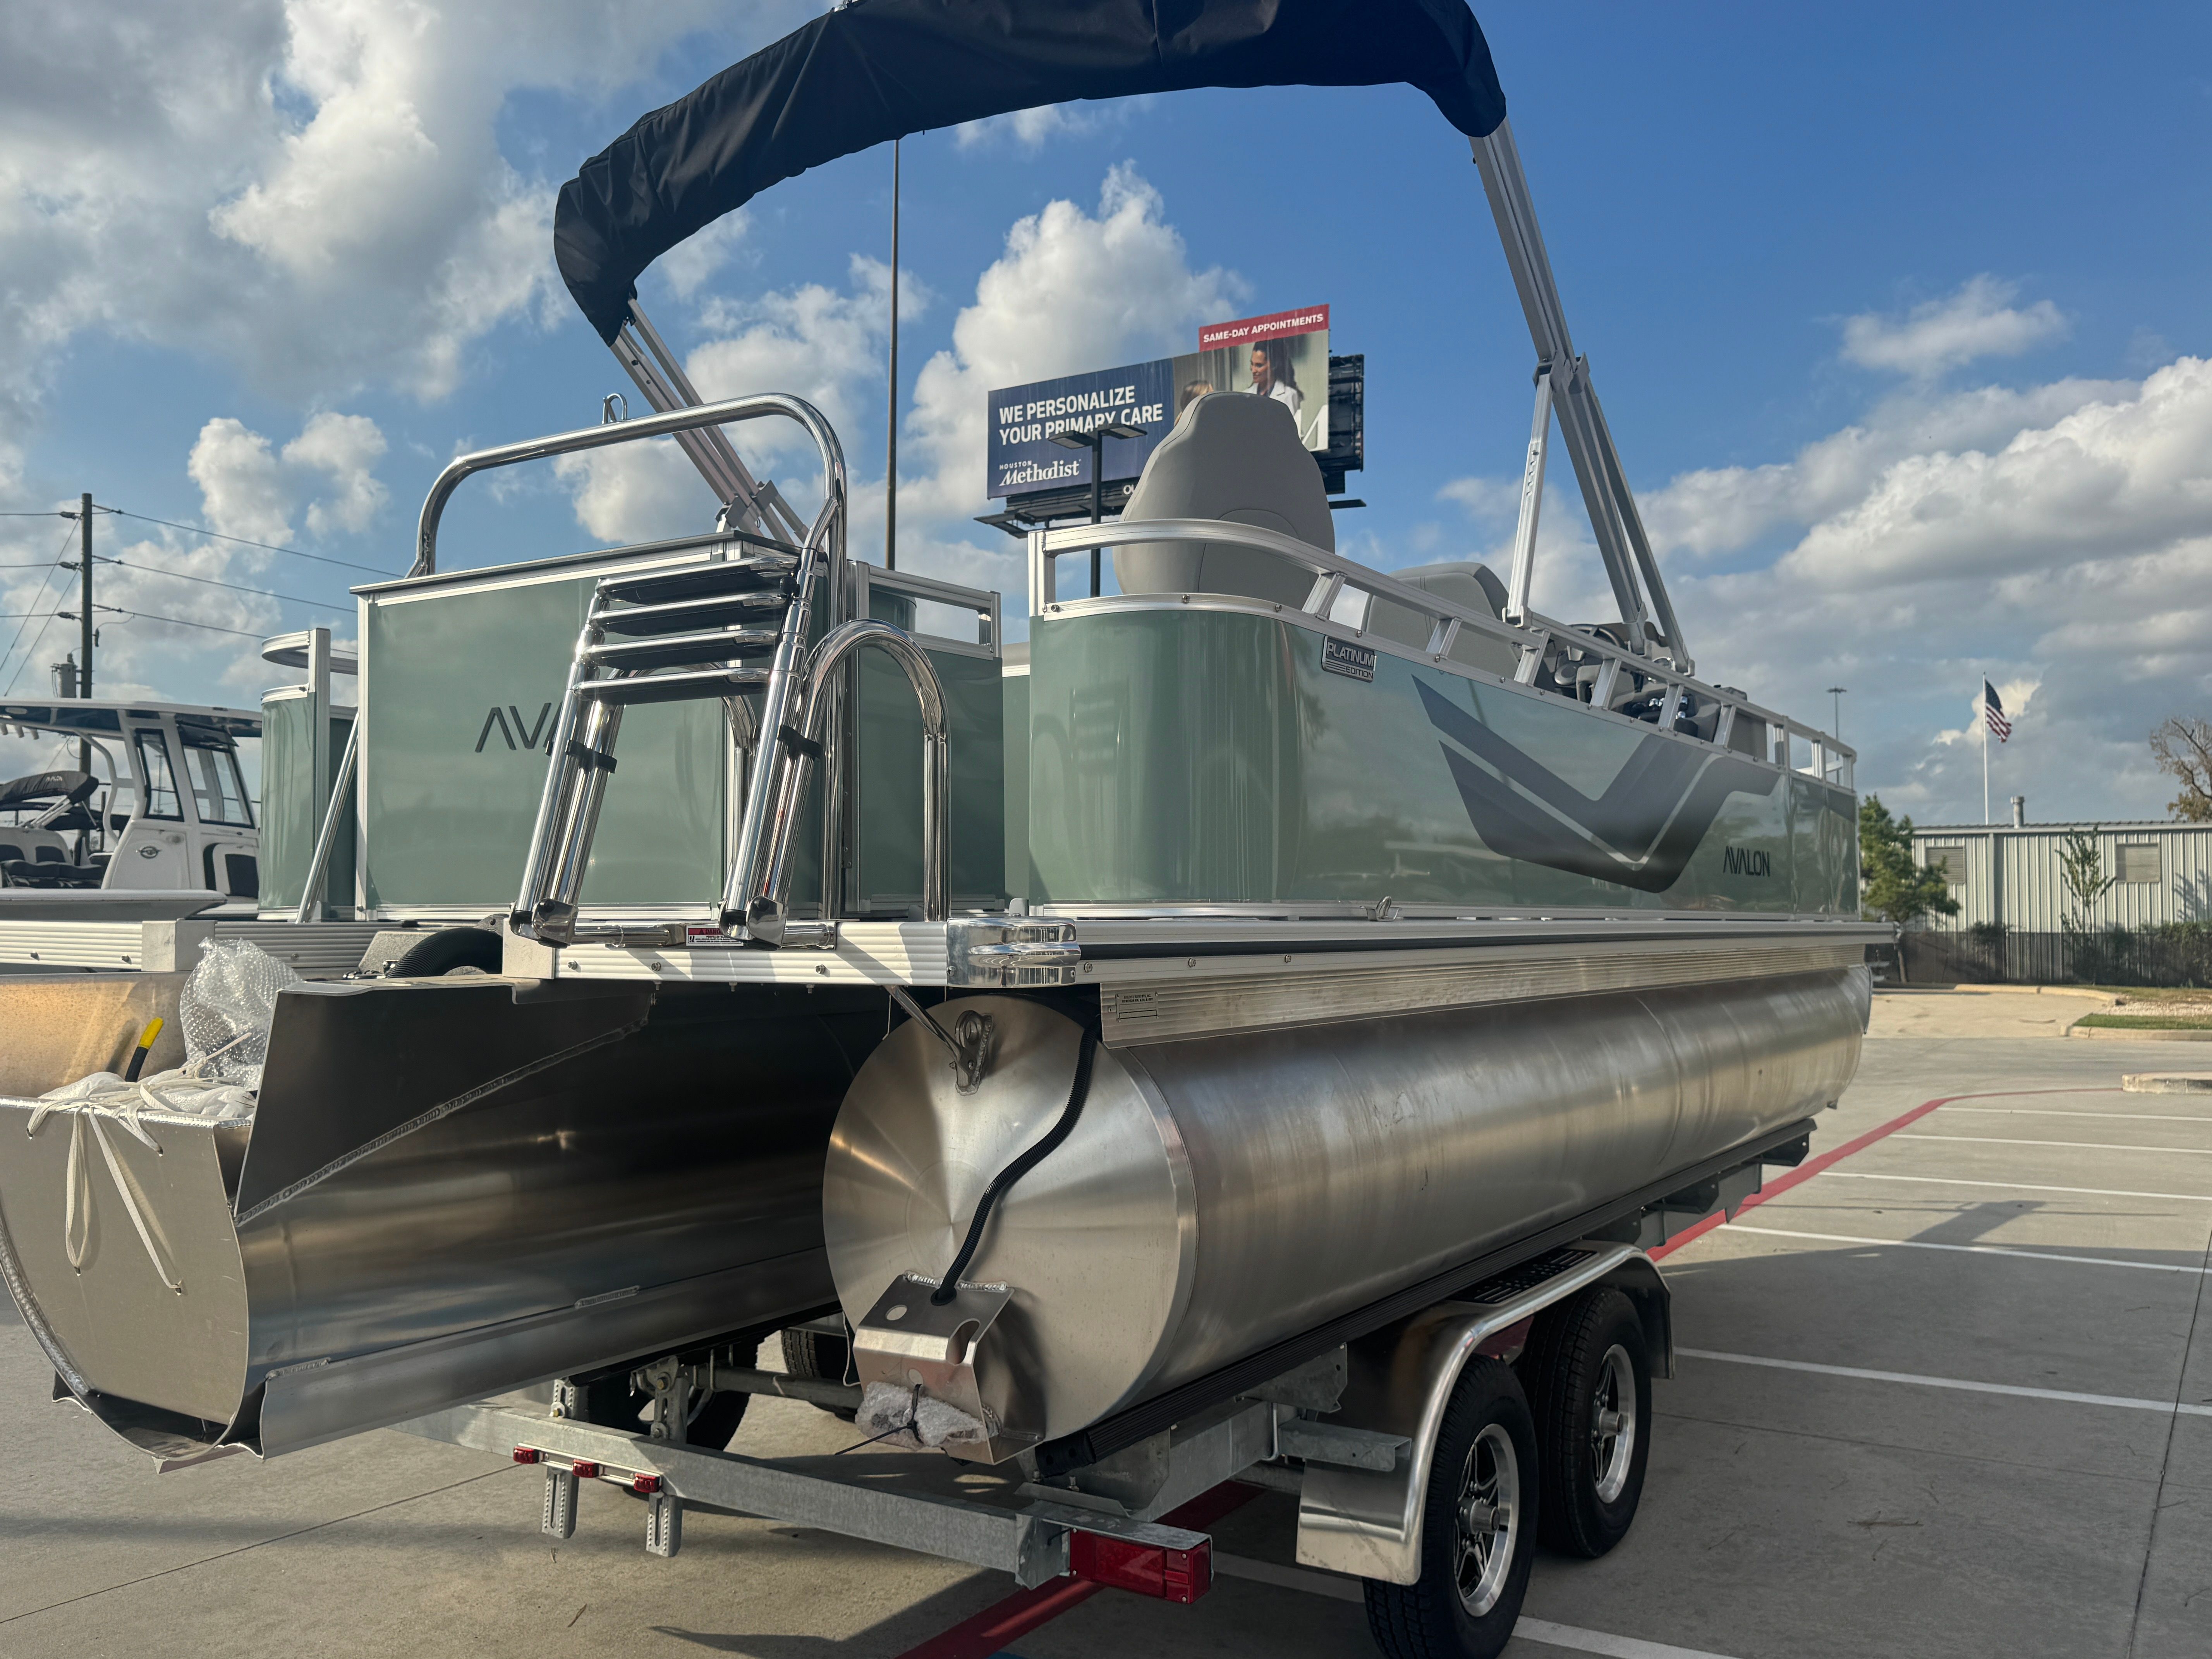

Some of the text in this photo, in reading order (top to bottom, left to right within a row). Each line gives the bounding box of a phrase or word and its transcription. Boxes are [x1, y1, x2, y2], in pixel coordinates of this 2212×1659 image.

[1203, 314, 1324, 343] SAME-DAY APPOINTMENTS
[999, 386, 1135, 424] WE PERSONALIZE
[1000, 424, 1042, 445] YOUR
[1121, 404, 1163, 425] CARE
[999, 460, 1032, 470] HOUSTON
[999, 460, 1080, 486] Methodist
[1327, 642, 1374, 666] PLATINUM
[1346, 666, 1374, 679] EDITION
[1723, 845, 1770, 877] AVALON
